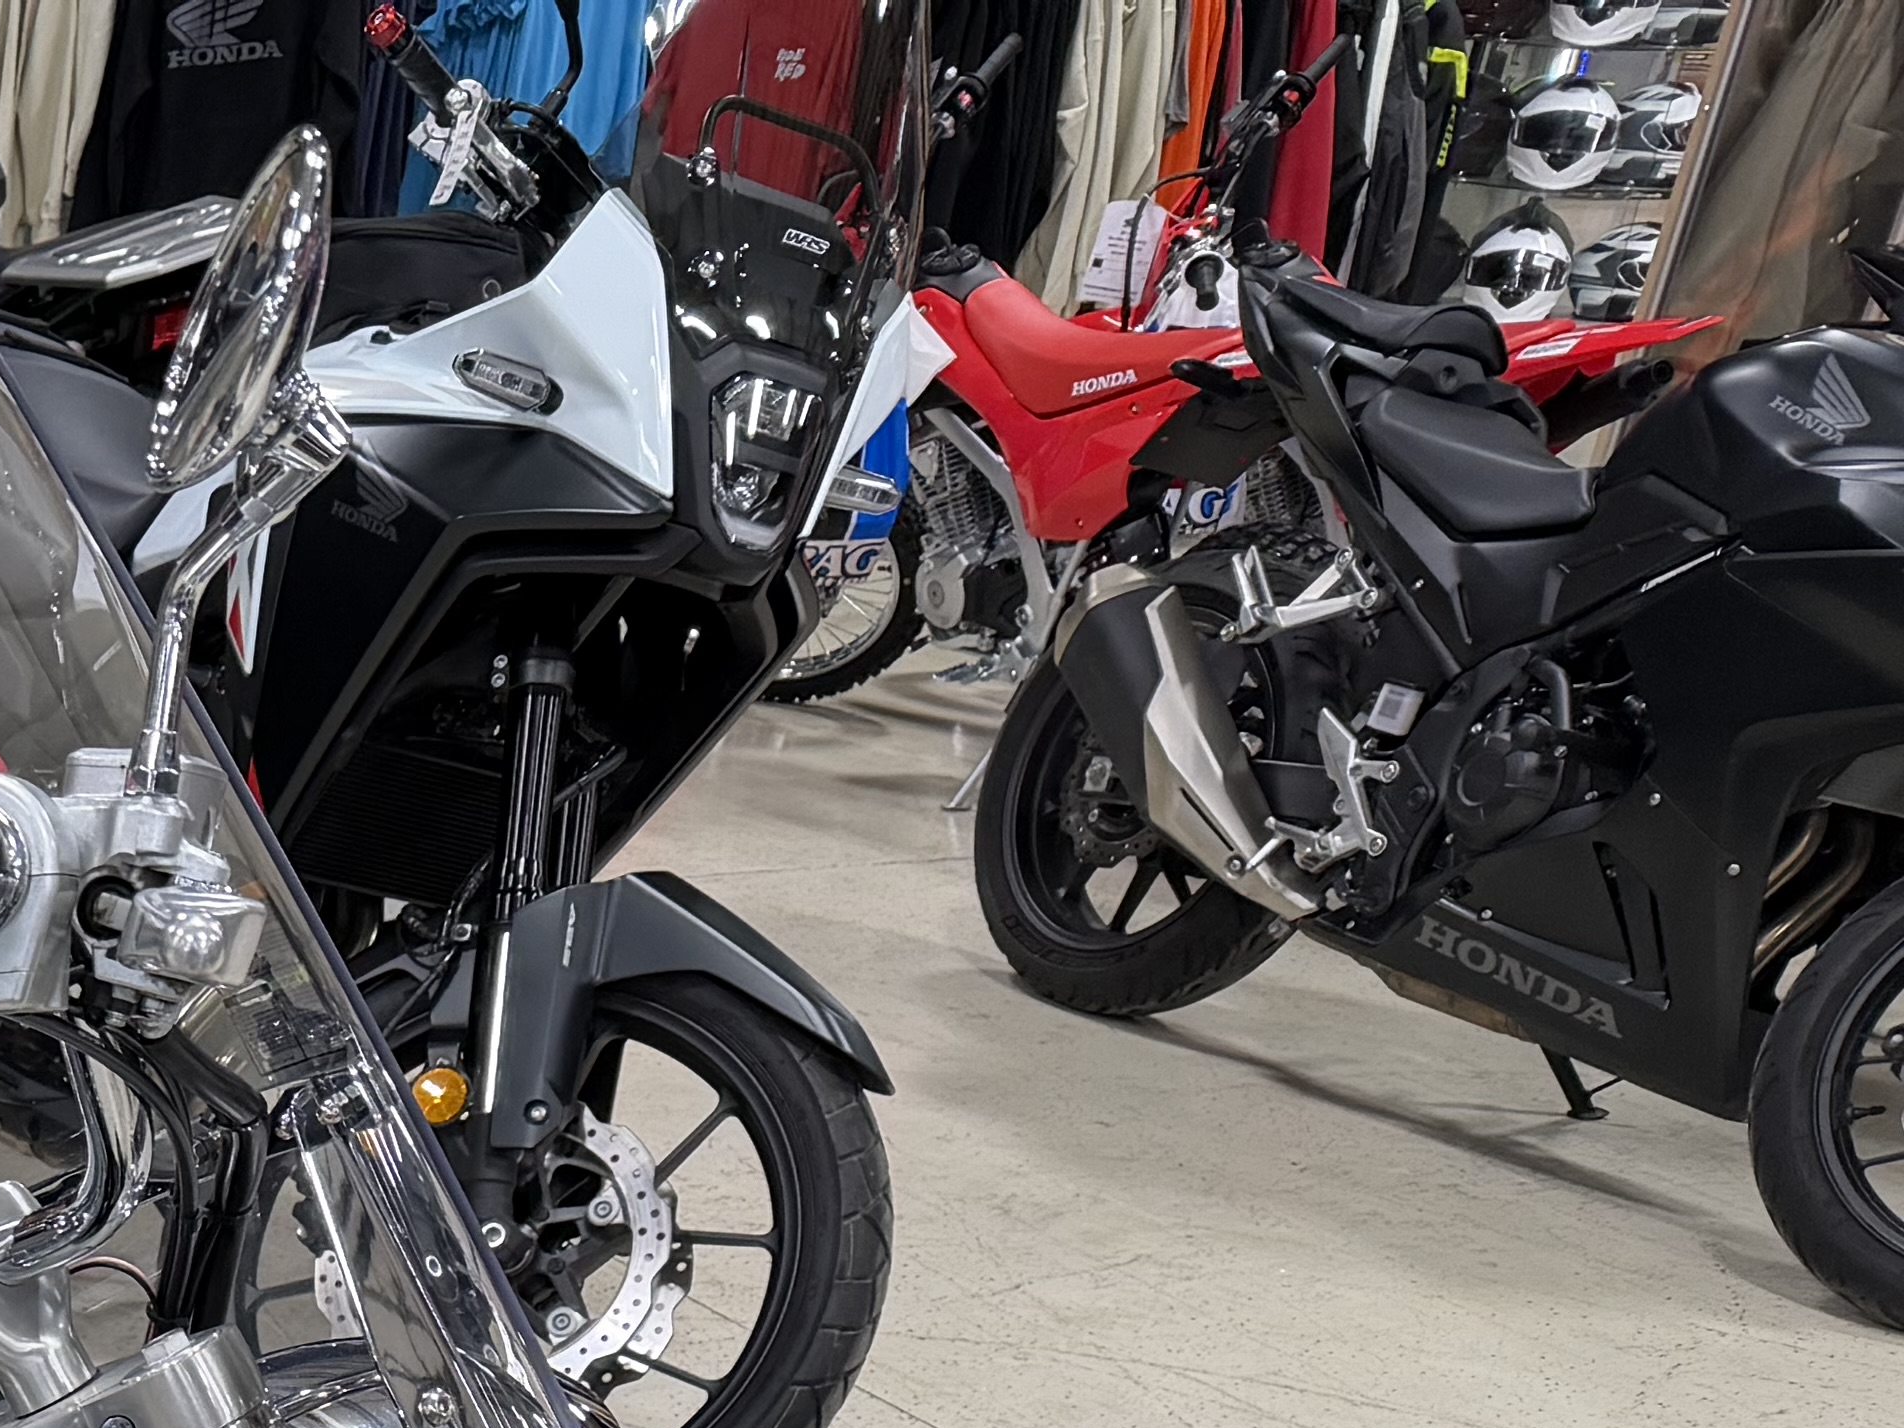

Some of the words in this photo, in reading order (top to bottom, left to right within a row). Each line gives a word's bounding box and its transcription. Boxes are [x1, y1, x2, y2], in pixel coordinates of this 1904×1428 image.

[167, 40, 284, 69] HONDA
[774, 62, 806, 82] RED
[1071, 368, 1138, 397] HONDA
[1768, 394, 1846, 446] HONDA
[332, 499, 398, 543] HONDA
[1414, 915, 1623, 1039] HONDA
